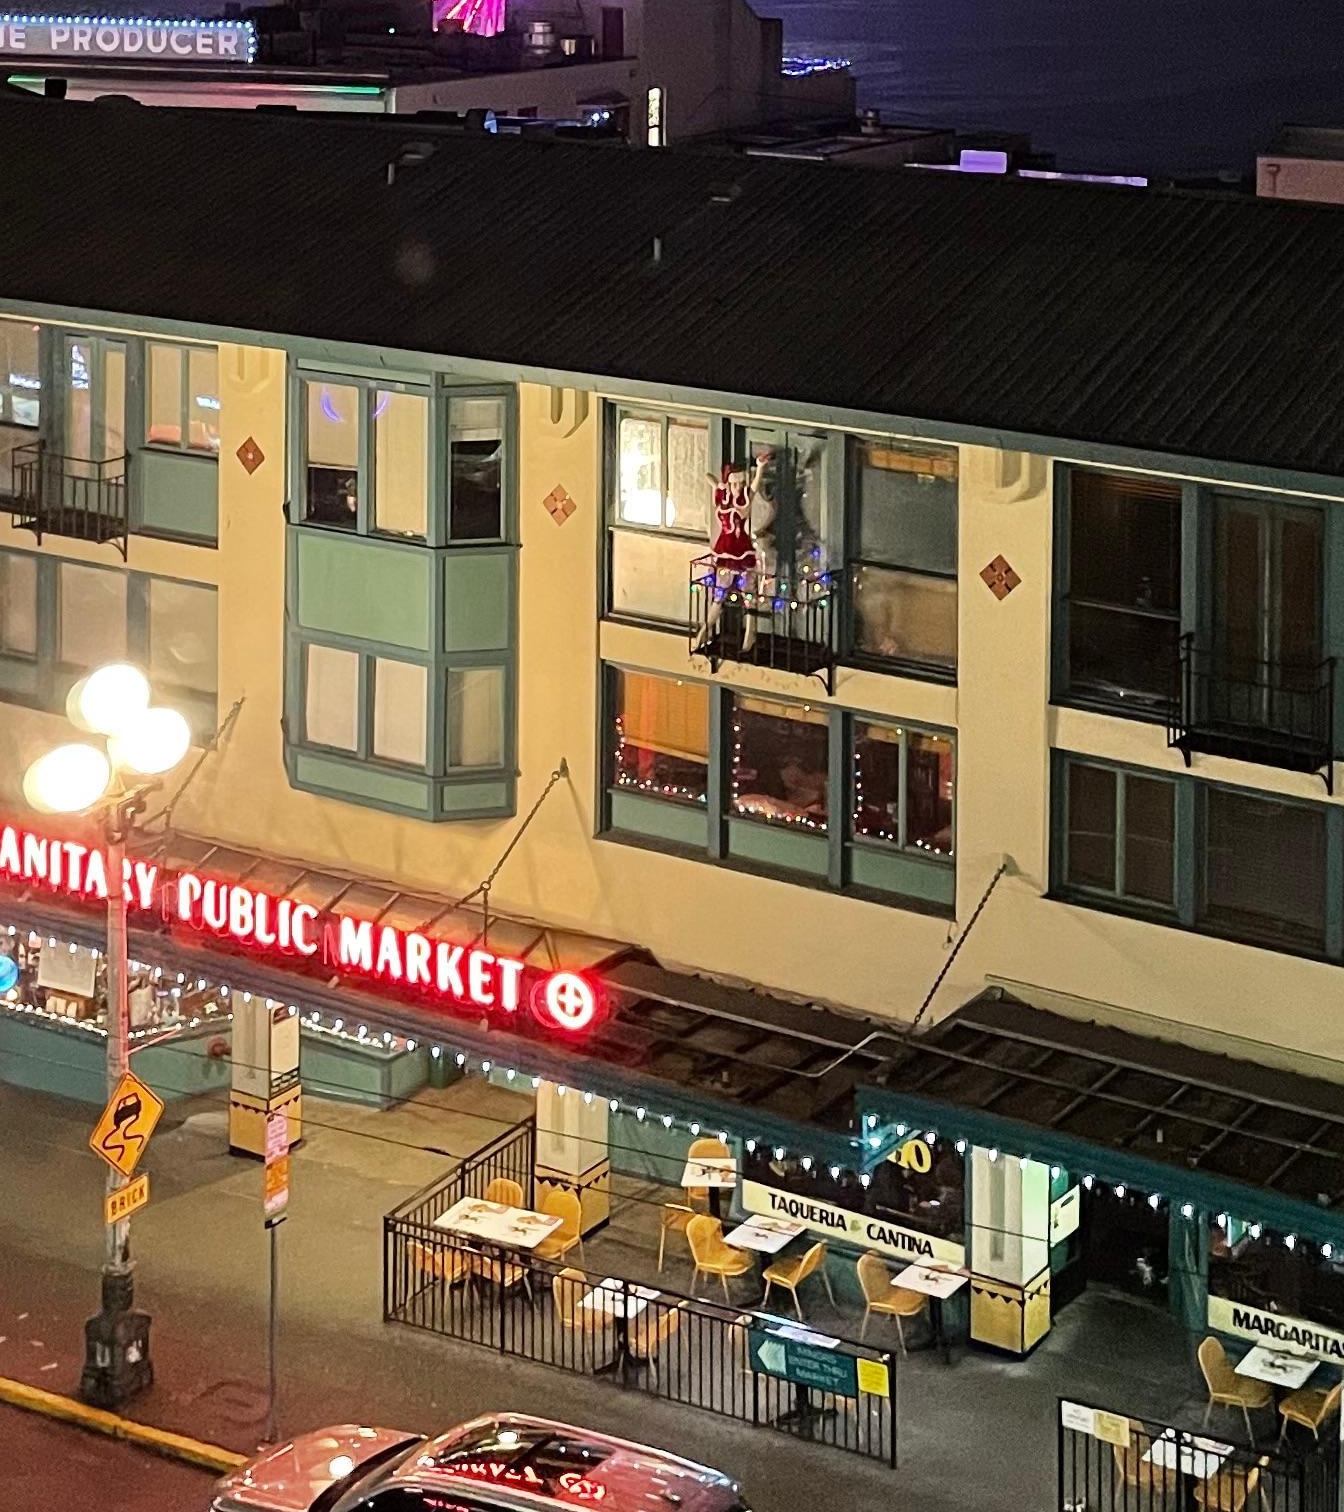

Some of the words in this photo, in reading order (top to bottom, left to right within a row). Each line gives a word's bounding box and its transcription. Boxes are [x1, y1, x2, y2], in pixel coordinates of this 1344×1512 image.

[51, 26, 238, 56] PRODUCER
[178, 872, 318, 955] PUBLIC
[339, 916, 524, 1012] MARKET
[110, 1184, 146, 1216] BRICK
[768, 1192, 847, 1231] TAQUERIA
[866, 1223, 935, 1258] CANTINA
